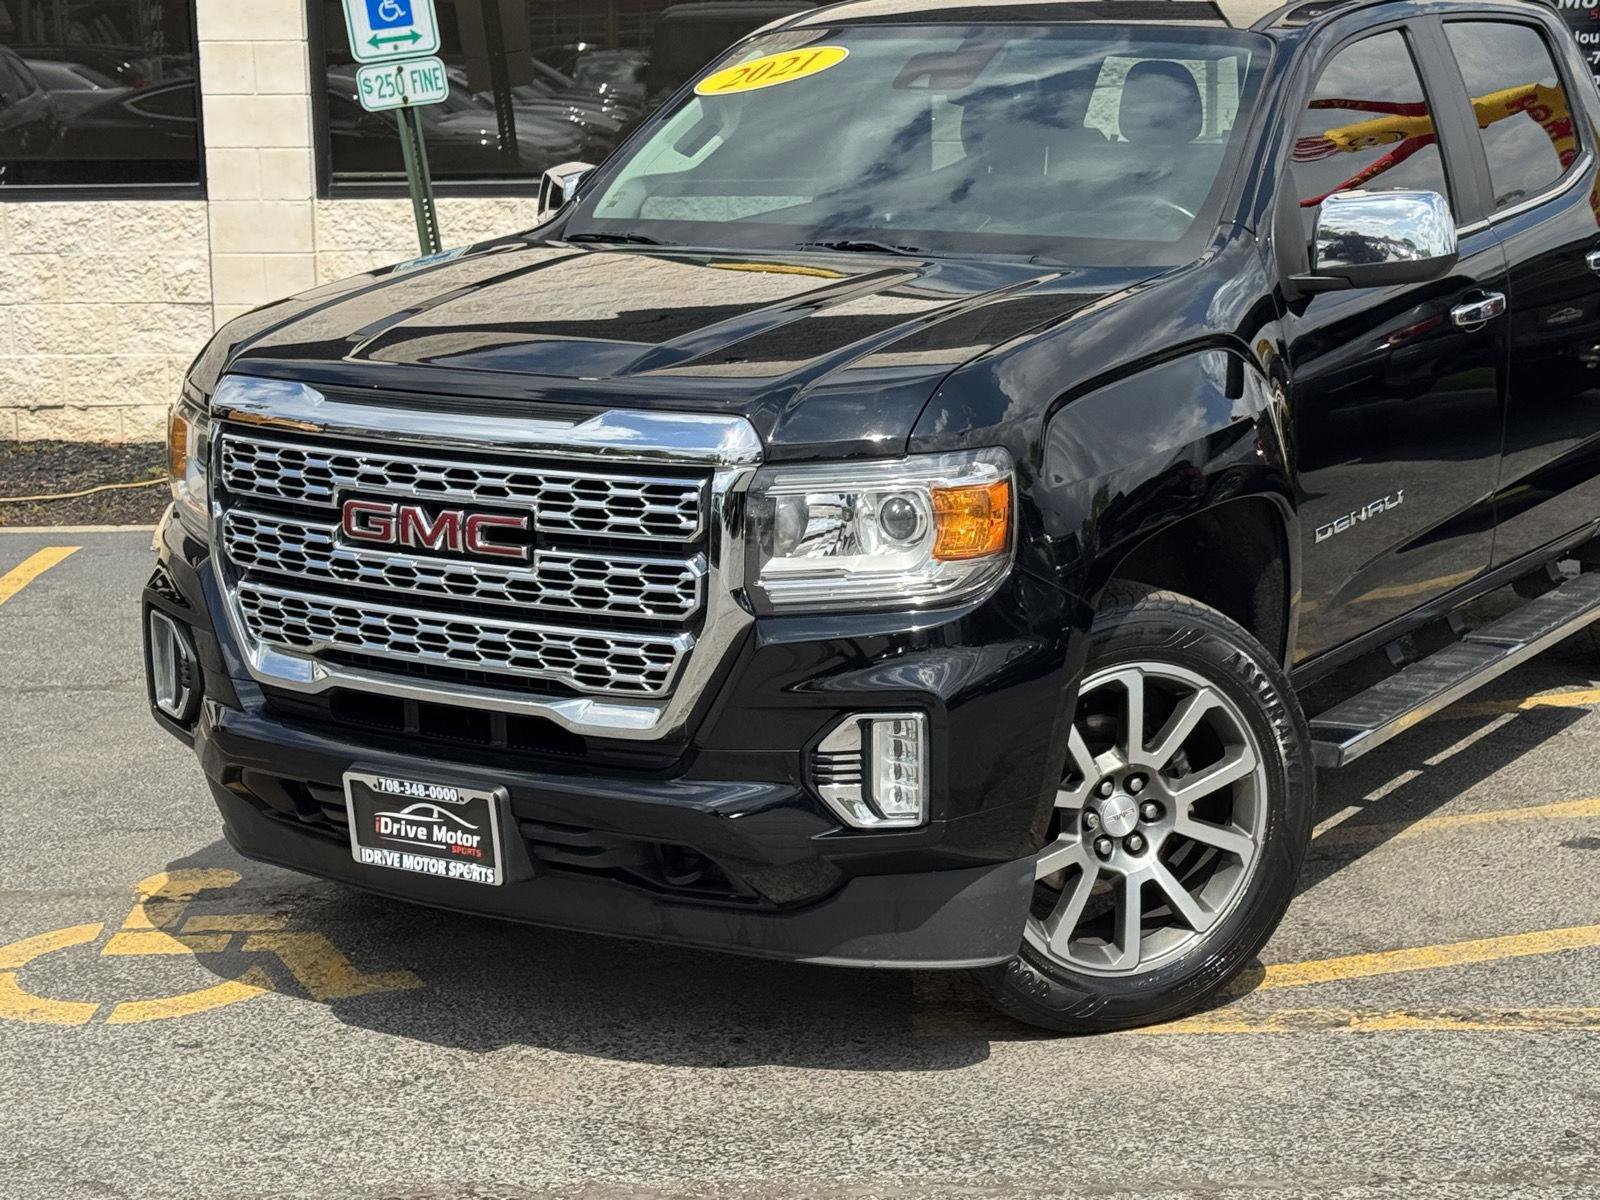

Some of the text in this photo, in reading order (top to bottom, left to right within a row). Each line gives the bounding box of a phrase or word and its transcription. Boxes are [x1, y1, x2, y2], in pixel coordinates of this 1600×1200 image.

[362, 68, 443, 98] $250 FINE
[717, 51, 824, 90] 2021
[342, 499, 528, 560] GMC
[1315, 489, 1404, 544] DENALI
[379, 778, 460, 801] 708-348-0000
[375, 816, 481, 848] iDrive Motor
[451, 845, 482, 858] SPORTS
[402, 854, 447, 876] MOTOR
[448, 862, 495, 883] SPORTS
